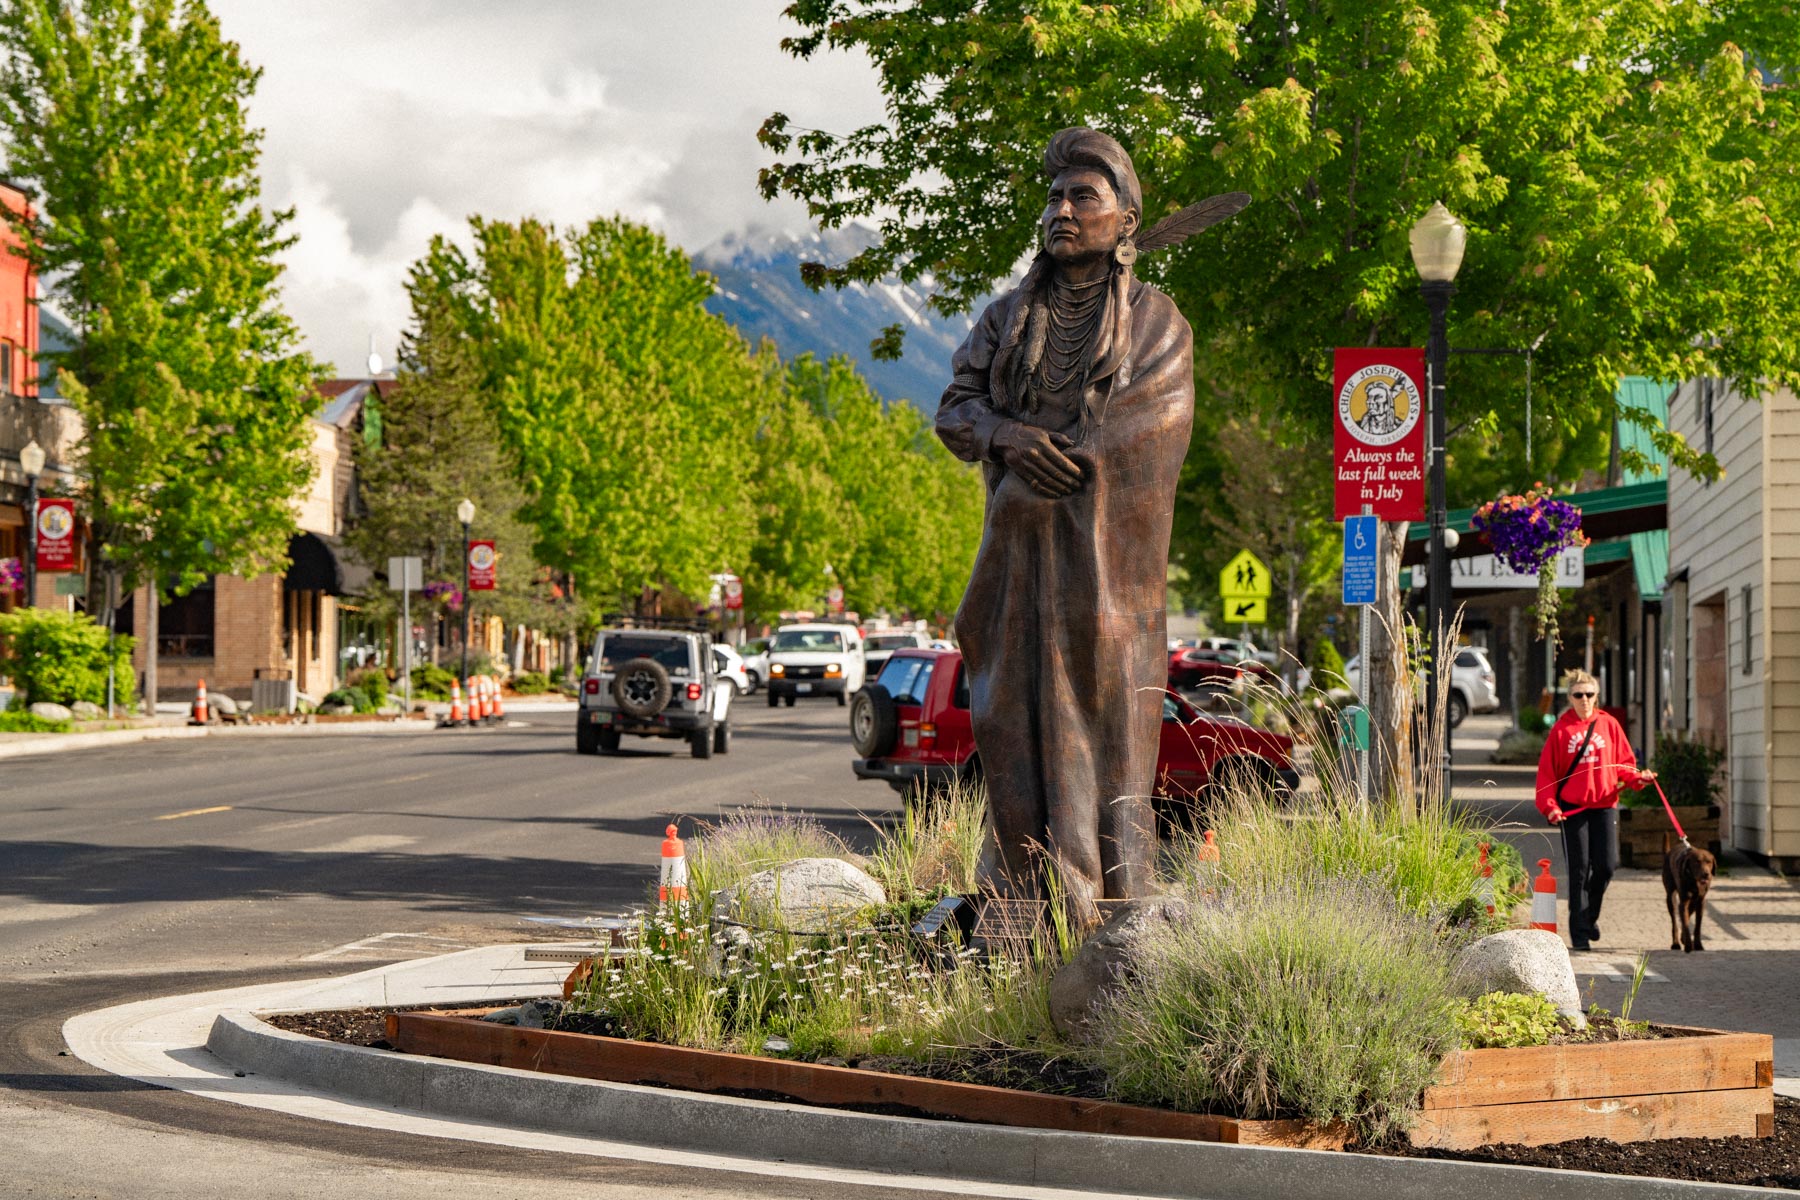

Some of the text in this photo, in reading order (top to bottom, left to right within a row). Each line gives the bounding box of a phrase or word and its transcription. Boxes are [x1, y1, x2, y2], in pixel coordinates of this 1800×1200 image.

[1341, 366, 1419, 415] CHIEF JOSEPH DAYS
[1344, 448, 1415, 465] Always the
[1338, 466, 1421, 484] last full week
[1361, 485, 1403, 502] in July
